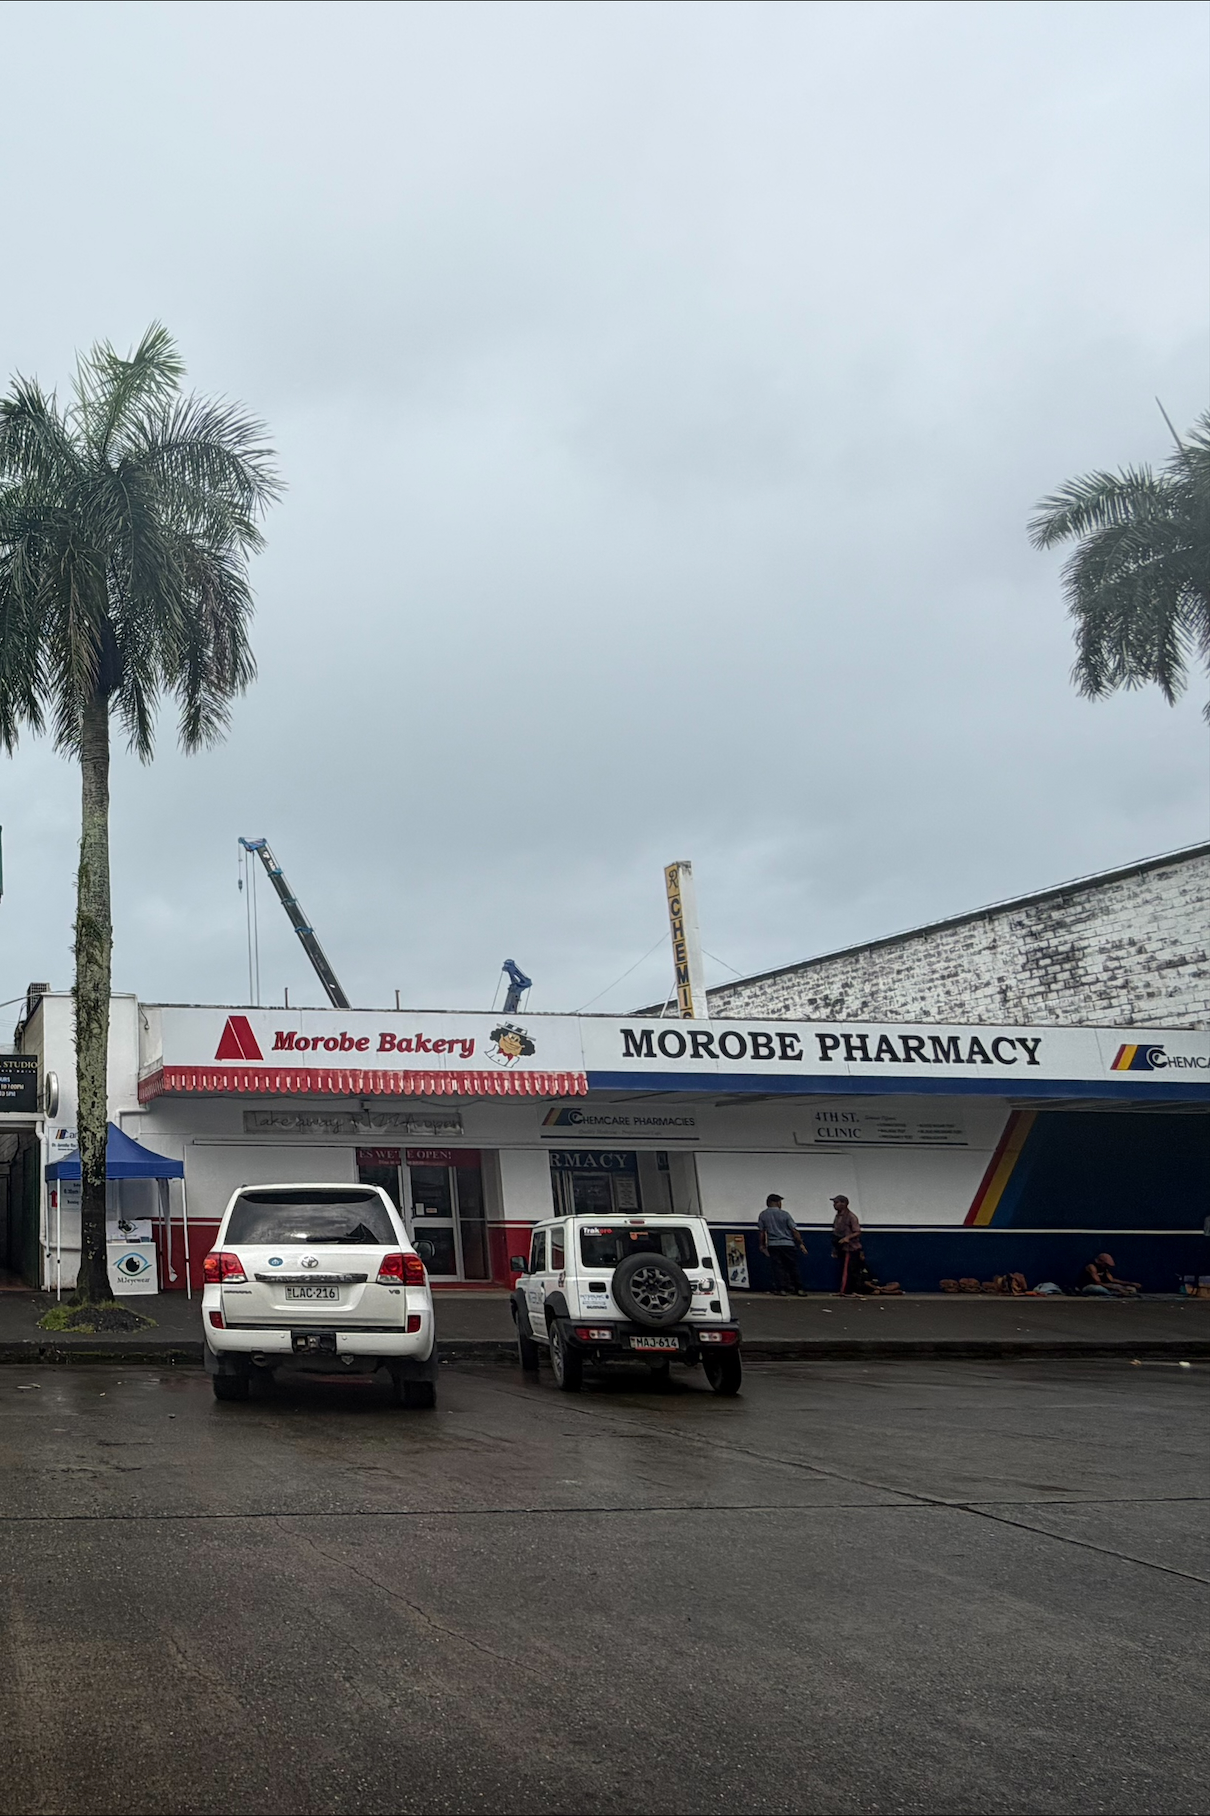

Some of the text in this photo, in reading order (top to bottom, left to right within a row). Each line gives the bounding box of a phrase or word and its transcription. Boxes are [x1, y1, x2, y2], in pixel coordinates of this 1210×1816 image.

[271, 1031, 475, 1059] Morobe Bakery
[619, 1028, 1042, 1066] MOROBE PHARMACY
[2, 1060, 38, 1069] STUDIO
[570, 1110, 695, 1126] CHEMCARE PHARMACIES
[815, 1112, 838, 1122] 4TH
[840, 1112, 860, 1123] ST.
[817, 1127, 862, 1139] CLINIC
[359, 1150, 451, 1160] ES WE'E OPEN!
[550, 1152, 627, 1169] RMACY
